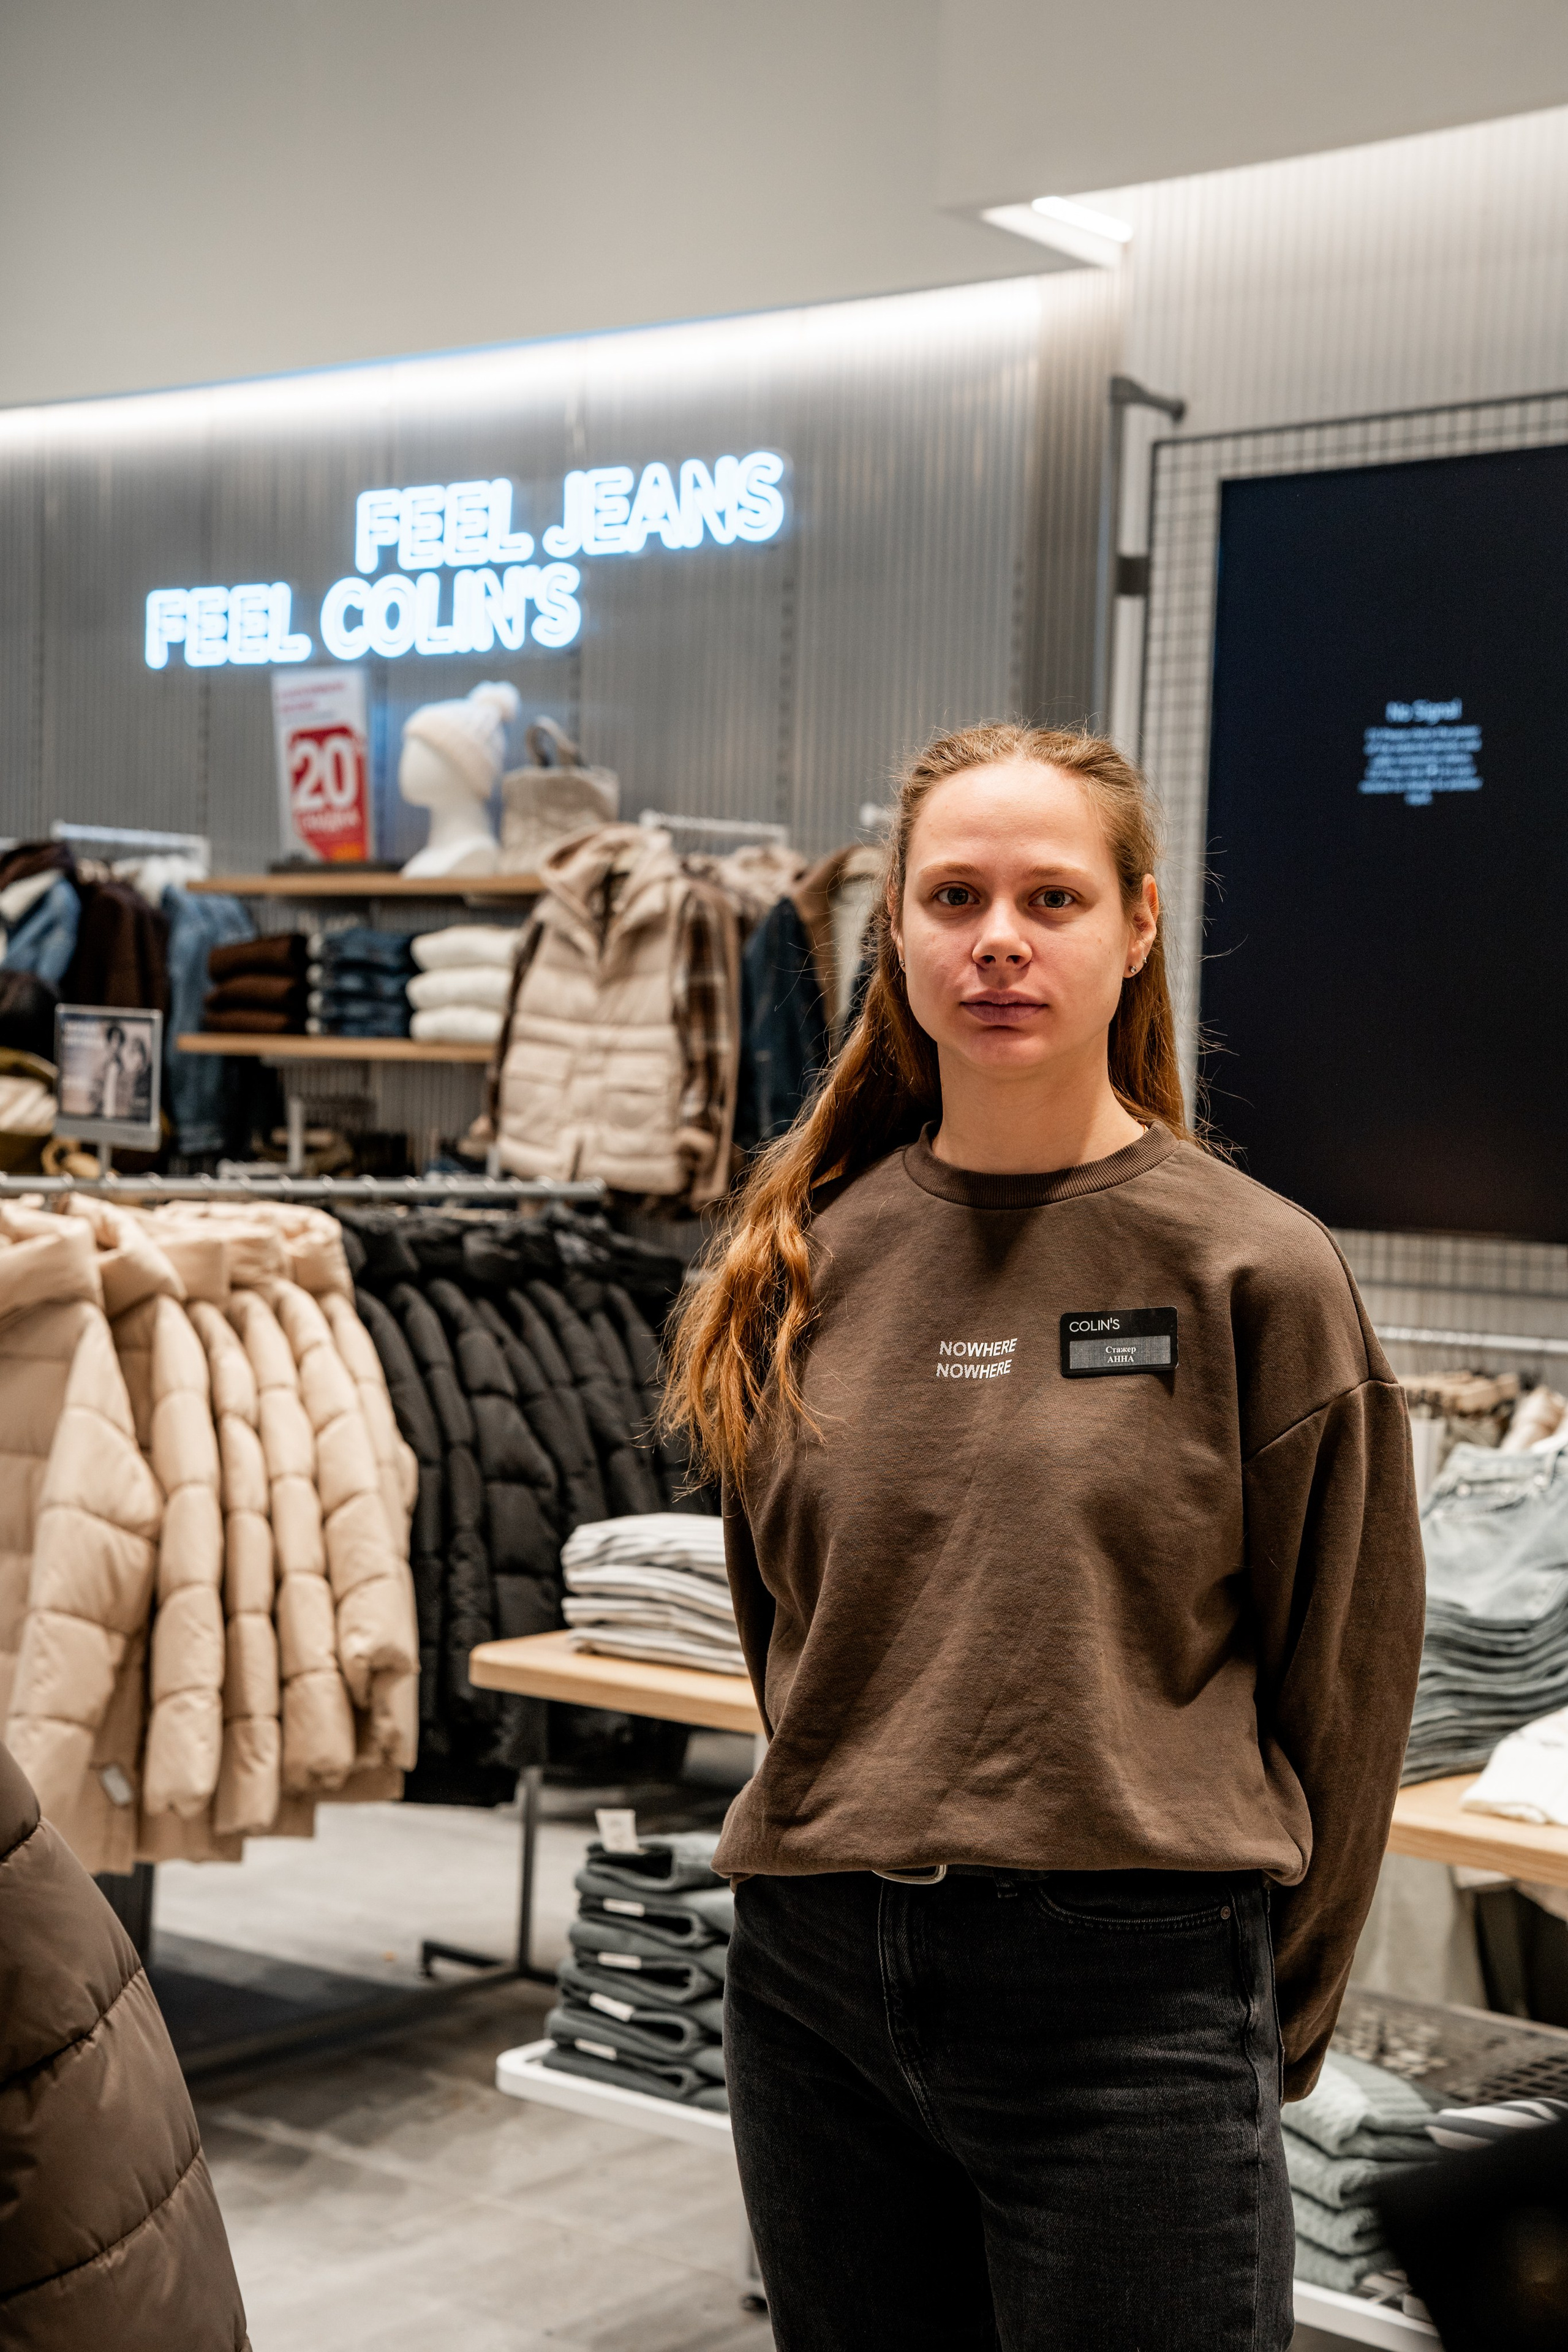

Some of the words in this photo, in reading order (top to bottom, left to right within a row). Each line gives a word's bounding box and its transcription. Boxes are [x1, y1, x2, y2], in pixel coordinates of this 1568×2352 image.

[355, 478, 534, 574] FEEL
[542, 451, 785, 558] JEANS
[145, 582, 312, 669] FEEL
[320, 562, 581, 661] COLIN'S
[291, 739, 356, 807] 20
[1069, 1317, 1120, 1332] COLIN'S
[939, 1338, 1017, 1357] NOWHERE
[1105, 1346, 1136, 1354] Стажер
[1107, 1355, 1134, 1363] АННА
[936, 1359, 1012, 1379] NOWHERE
